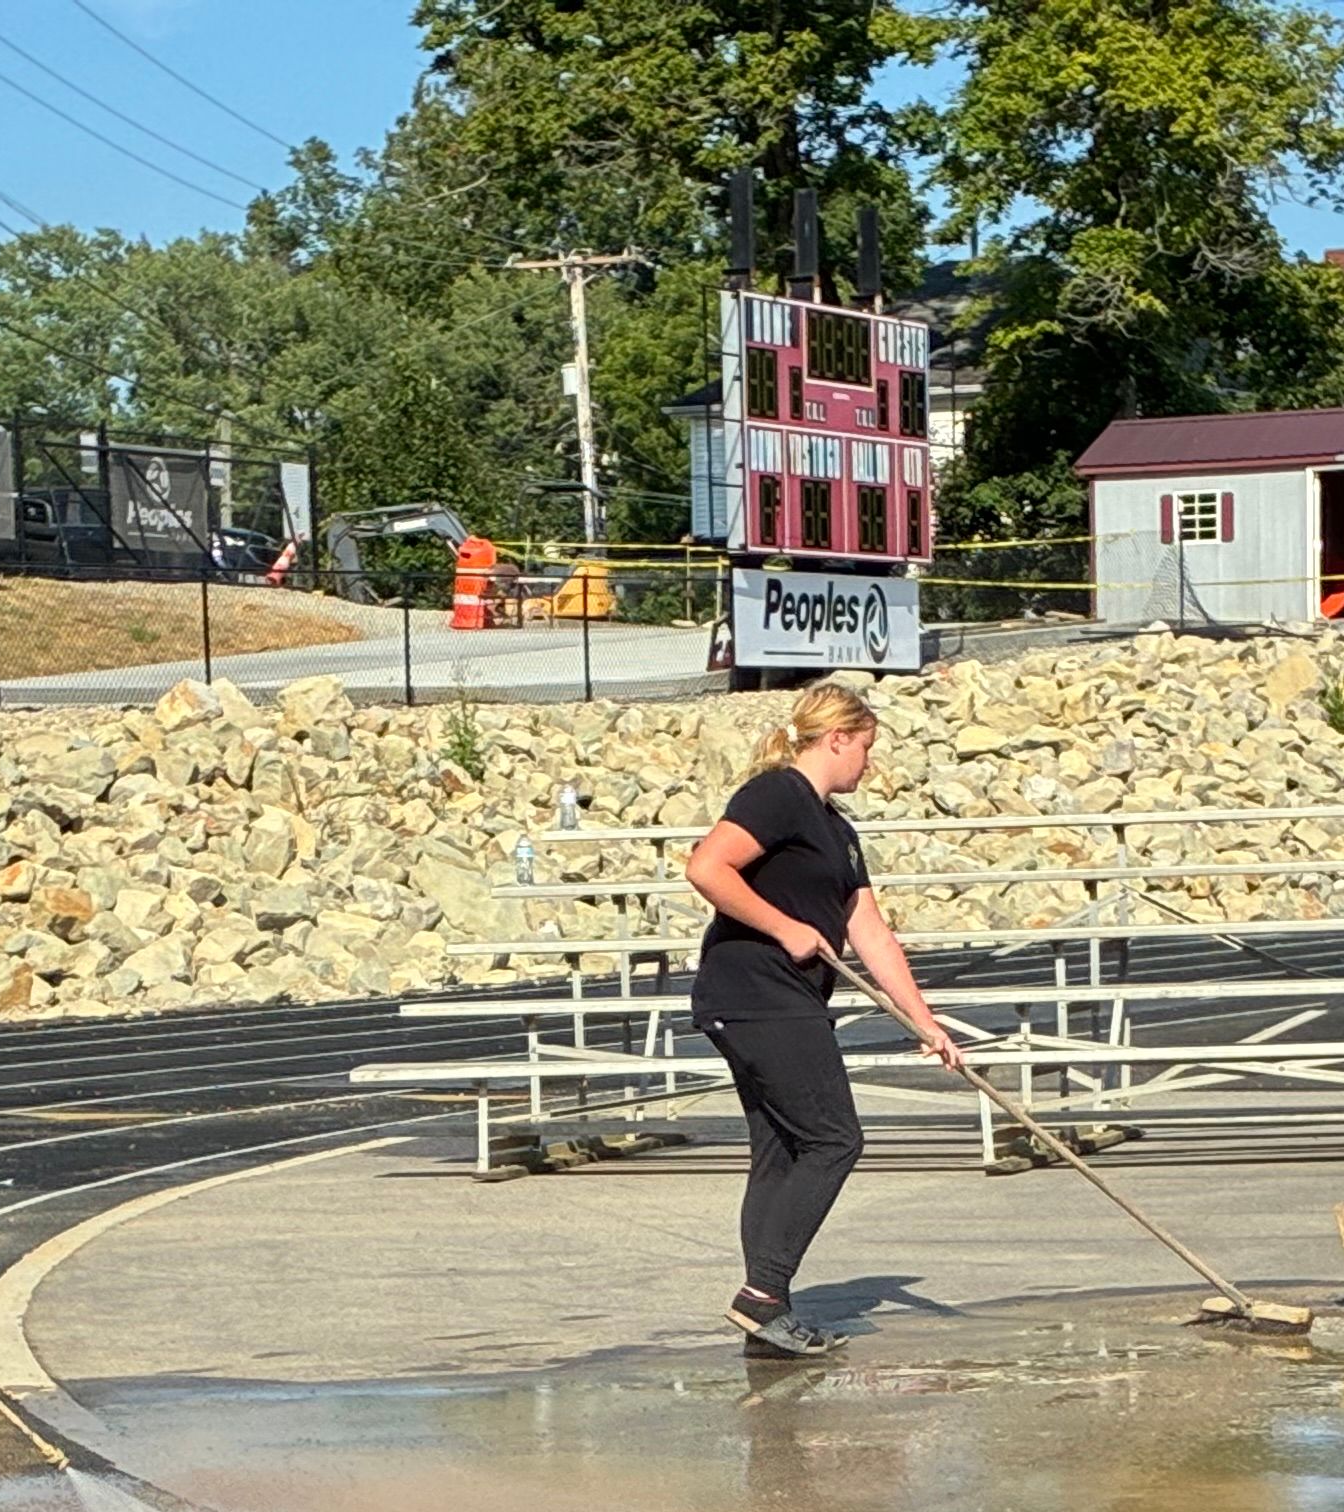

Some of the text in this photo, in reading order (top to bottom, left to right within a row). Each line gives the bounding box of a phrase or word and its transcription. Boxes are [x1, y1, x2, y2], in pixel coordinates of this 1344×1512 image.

[878, 321, 925, 369] GUESTS
[763, 578, 861, 643] Peoples
[827, 645, 862, 664] BANK
